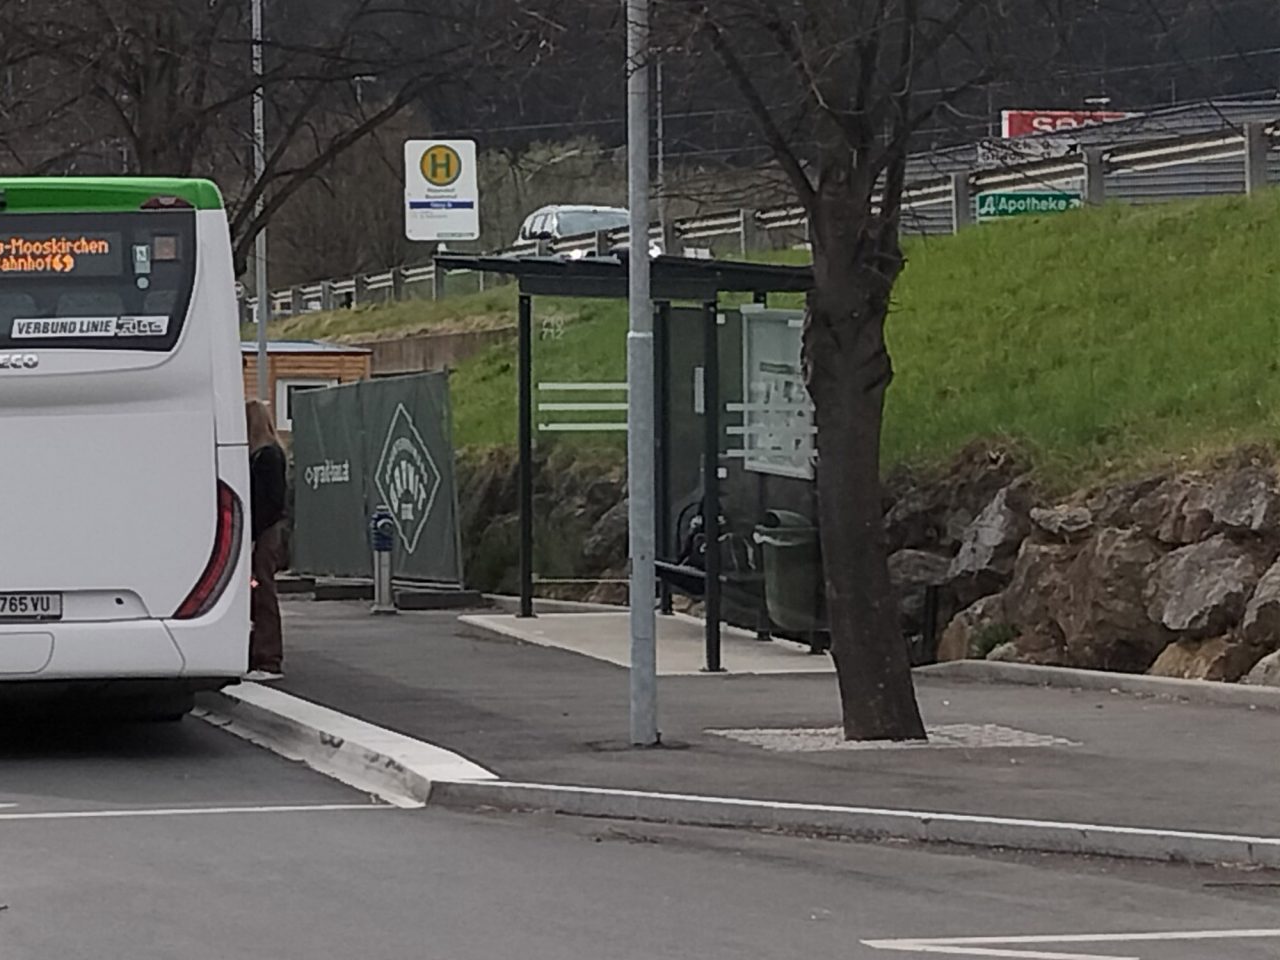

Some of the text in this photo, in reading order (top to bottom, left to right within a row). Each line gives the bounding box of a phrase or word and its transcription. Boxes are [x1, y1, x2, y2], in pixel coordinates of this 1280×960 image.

[430, 153, 451, 178] H
[999, 196, 1066, 215] Apotheke
[17, 321, 77, 335] VERBUND
[78, 320, 113, 334] LINIE
